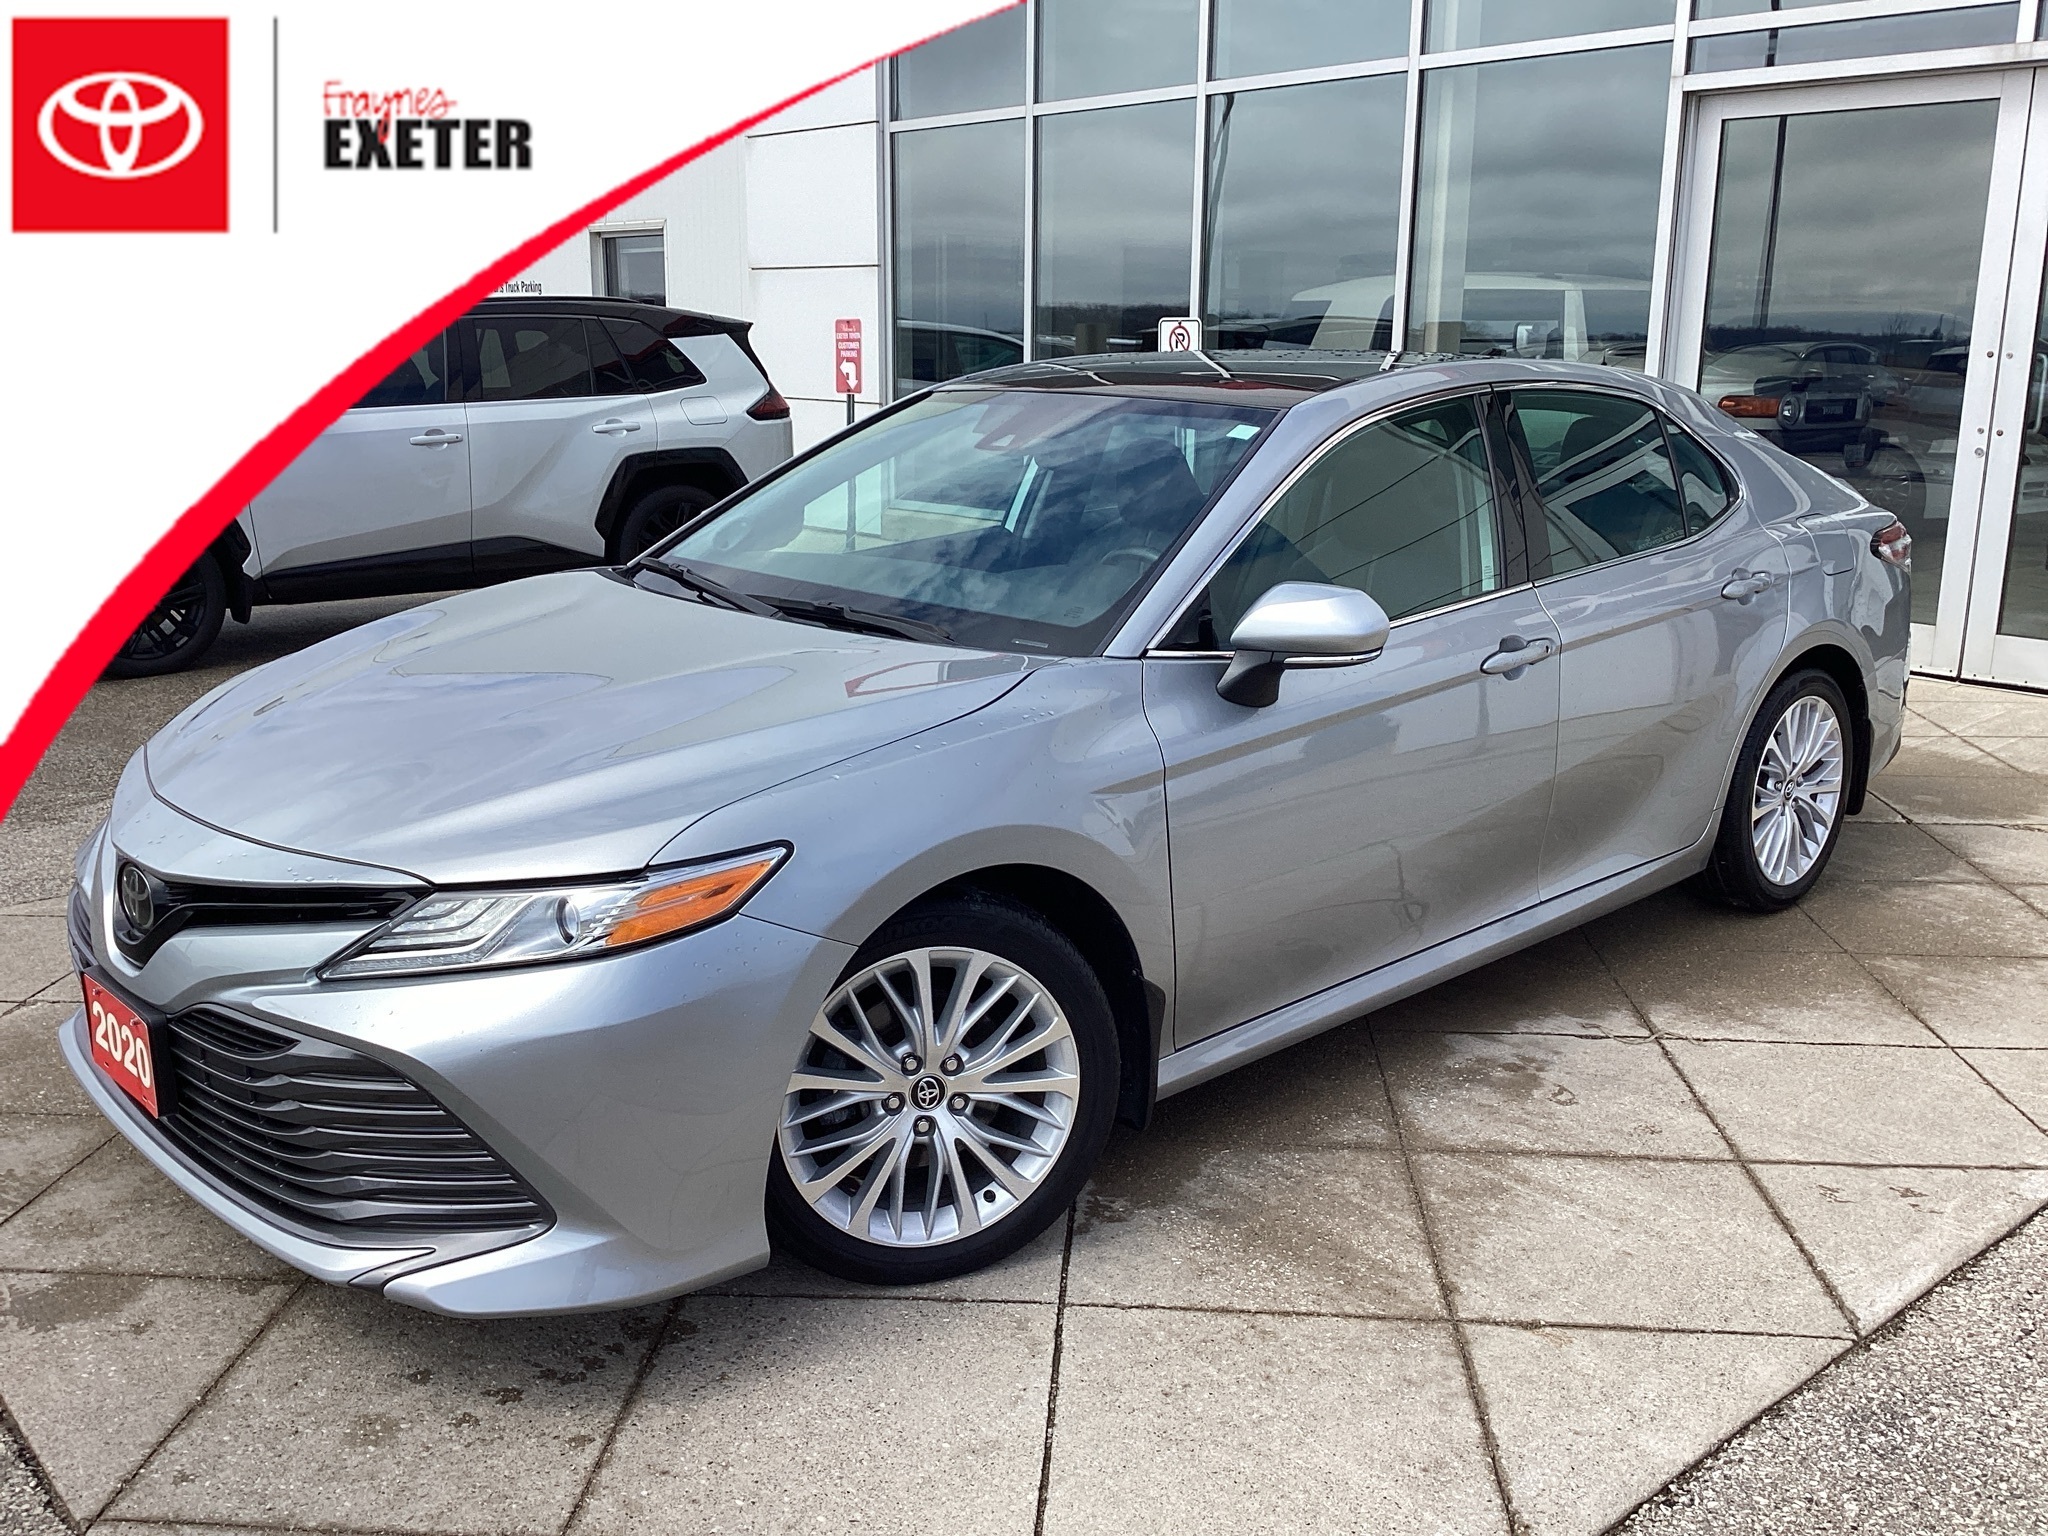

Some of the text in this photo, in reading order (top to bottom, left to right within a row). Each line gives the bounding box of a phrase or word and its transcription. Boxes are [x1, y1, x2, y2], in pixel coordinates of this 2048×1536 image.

[505, 281, 520, 293] Truck
[521, 280, 542, 295] Parking
[837, 341, 860, 350] CUSTOMER
[840, 350, 858, 358] PARKING
[92, 1000, 152, 1089] 2020
